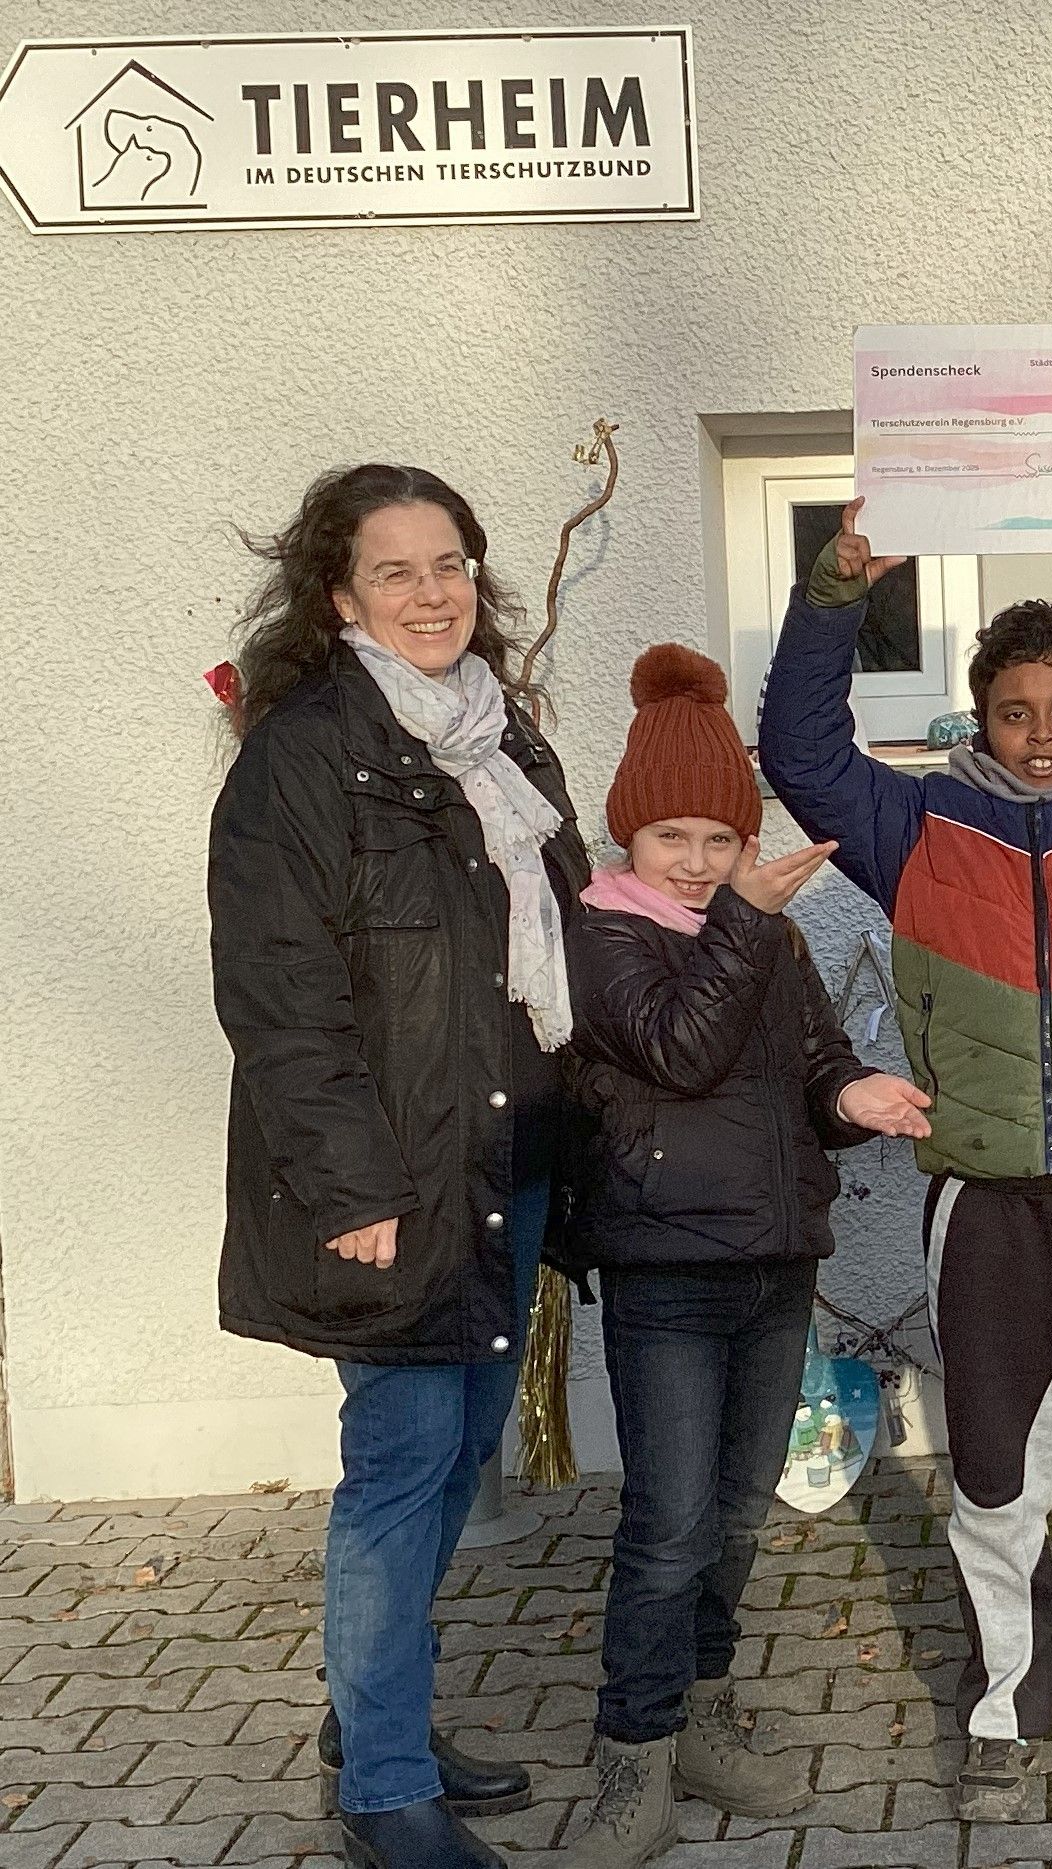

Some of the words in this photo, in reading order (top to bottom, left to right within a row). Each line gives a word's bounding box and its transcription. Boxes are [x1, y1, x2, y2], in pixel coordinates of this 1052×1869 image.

[241, 76, 651, 155] TIERHEIM
[246, 167, 275, 185] IM
[286, 164, 425, 184] DEUTSCHEN
[436, 159, 652, 181] TIERSCHUTZBUND
[870, 364, 981, 380] Spendenscheck
[871, 418, 950, 428] Tierschutzverein
[951, 417, 1007, 428] Regensburg
[1008, 417, 1026, 427] e.V.
[924, 463, 961, 473] Dezember
